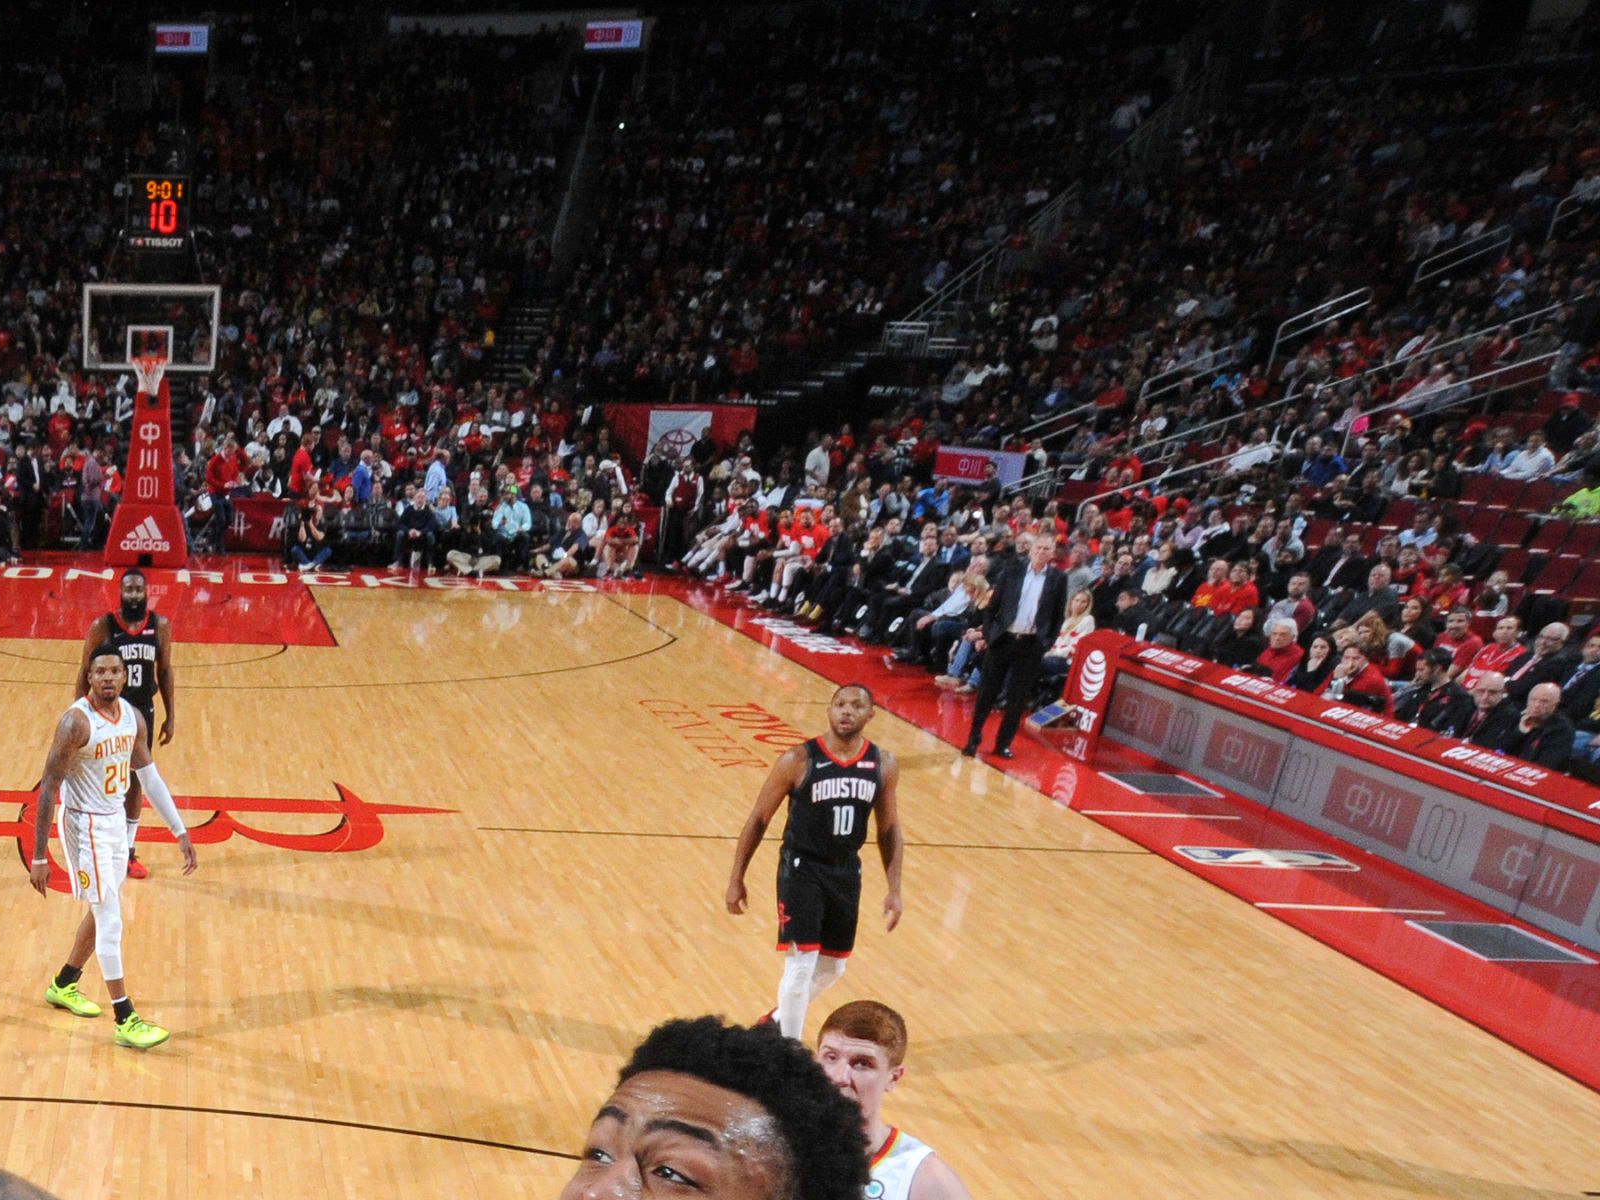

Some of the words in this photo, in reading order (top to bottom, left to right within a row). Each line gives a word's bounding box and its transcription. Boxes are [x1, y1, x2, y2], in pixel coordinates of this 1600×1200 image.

[146, 180, 183, 199] 9:01
[149, 200, 177, 234] 10
[144, 237, 183, 247] TISSOT
[120, 538, 170, 551] adidas
[118, 643, 156, 661] OUSTON
[127, 663, 142, 687] 13
[707, 702, 810, 752] TOYO
[95, 736, 135, 759] ATLANT
[105, 761, 128, 794] 24
[812, 777, 876, 803] HOUSTON
[832, 805, 854, 836] 10
